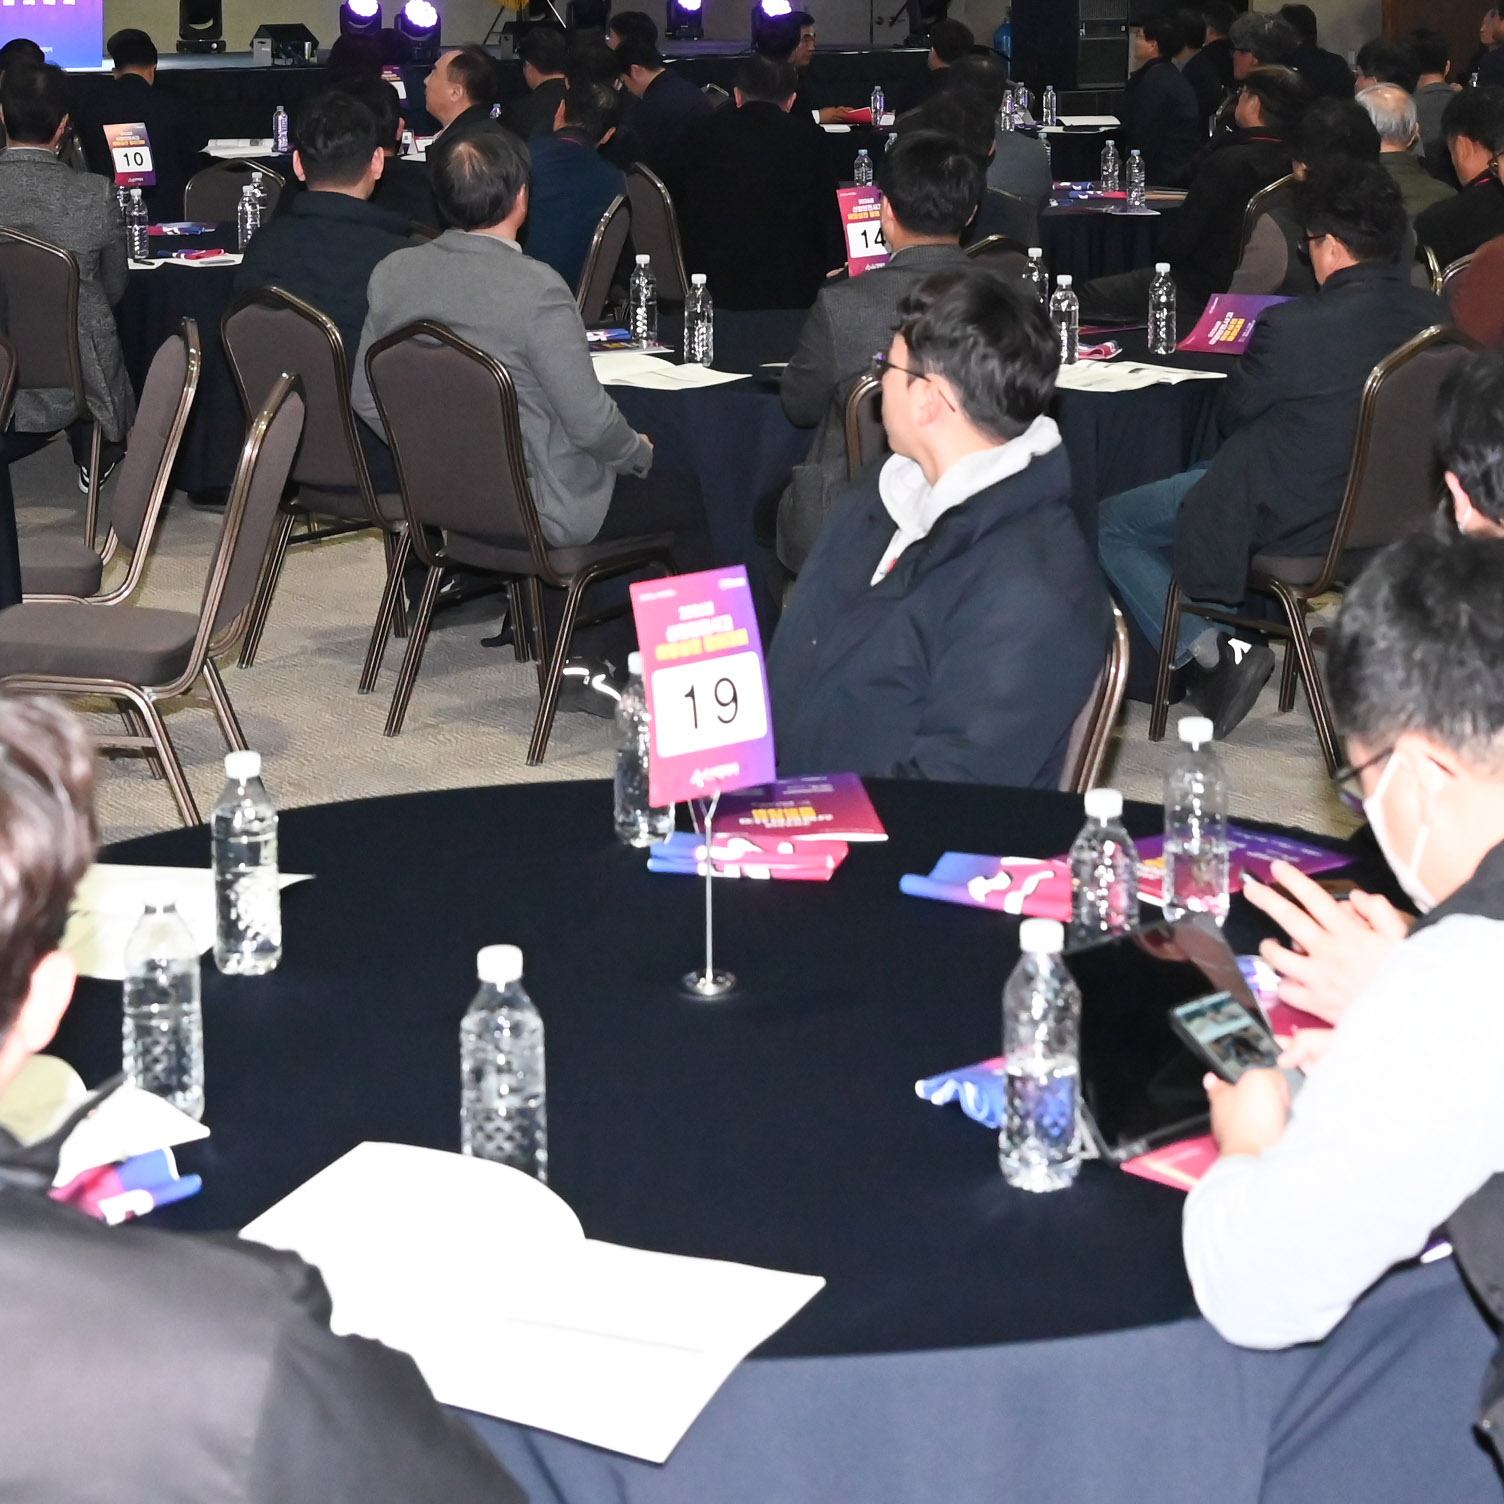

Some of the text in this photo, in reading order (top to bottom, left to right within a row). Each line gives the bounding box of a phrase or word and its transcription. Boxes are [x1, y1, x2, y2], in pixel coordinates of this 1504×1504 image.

[123, 152, 143, 167] 10
[861, 228, 886, 249] 14
[684, 677, 738, 729] 19
